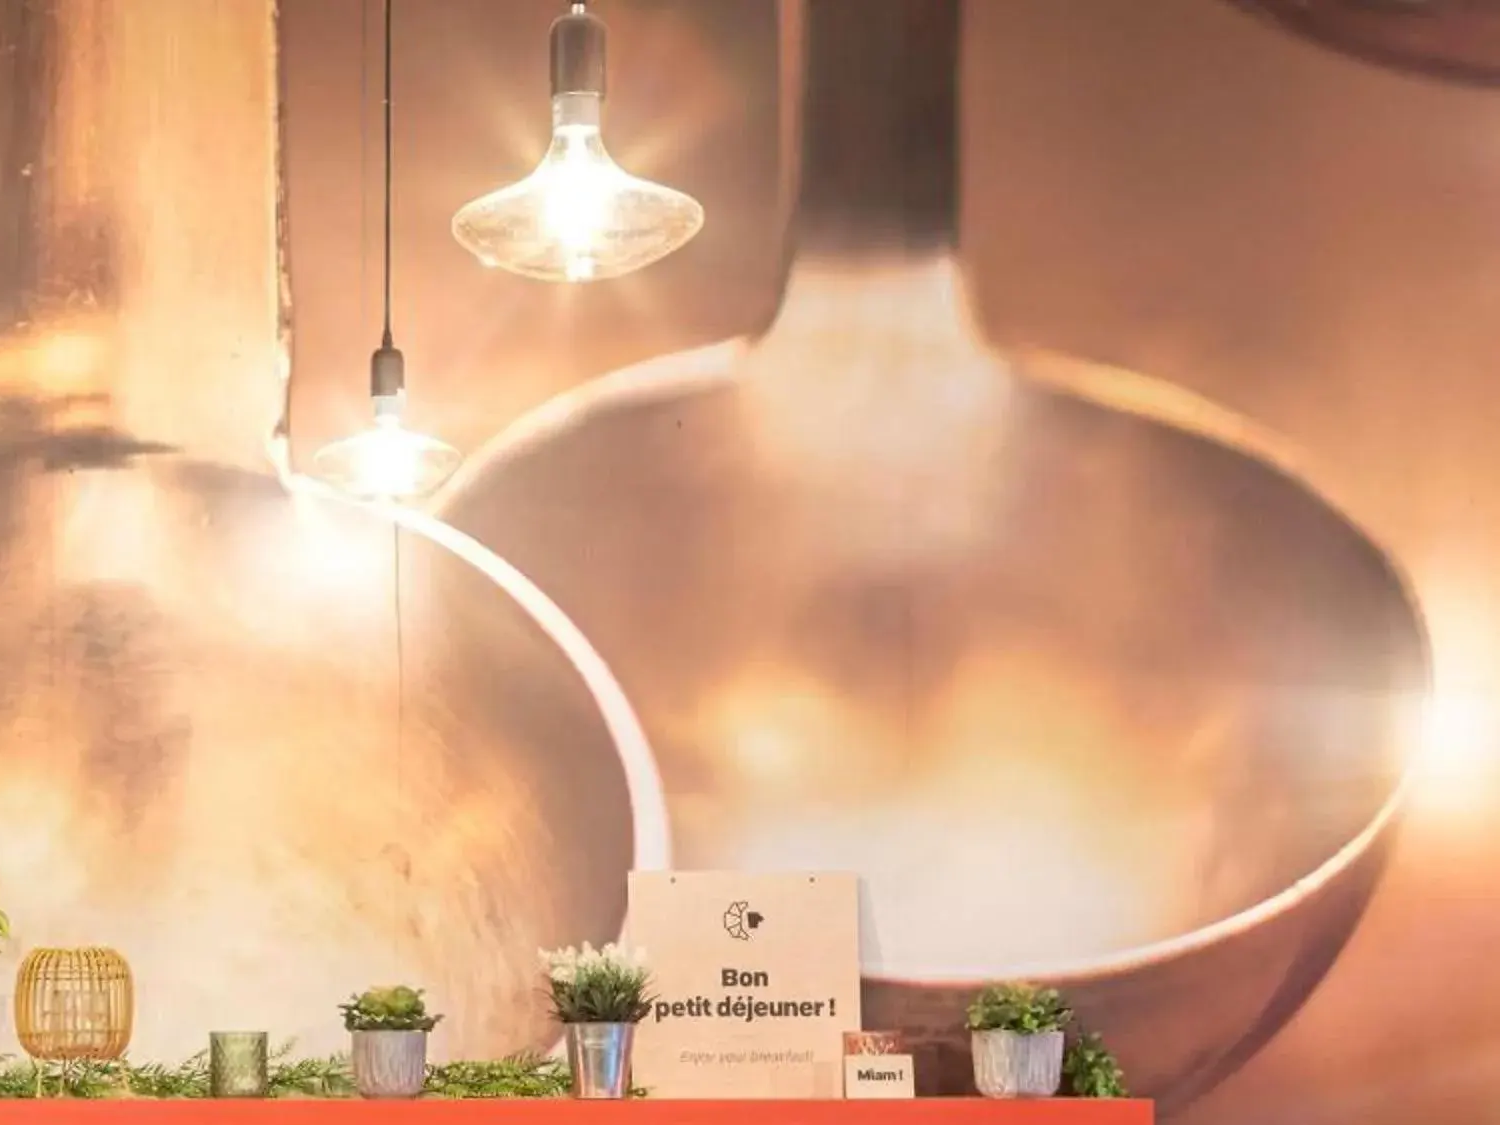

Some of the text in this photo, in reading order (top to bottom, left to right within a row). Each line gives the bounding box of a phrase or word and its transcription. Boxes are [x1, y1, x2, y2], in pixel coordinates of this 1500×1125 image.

[721, 968, 769, 987] Bon
[655, 996, 712, 1022] petit
[717, 997, 824, 1022] déjeuner
[857, 1069, 897, 1082] Miam
